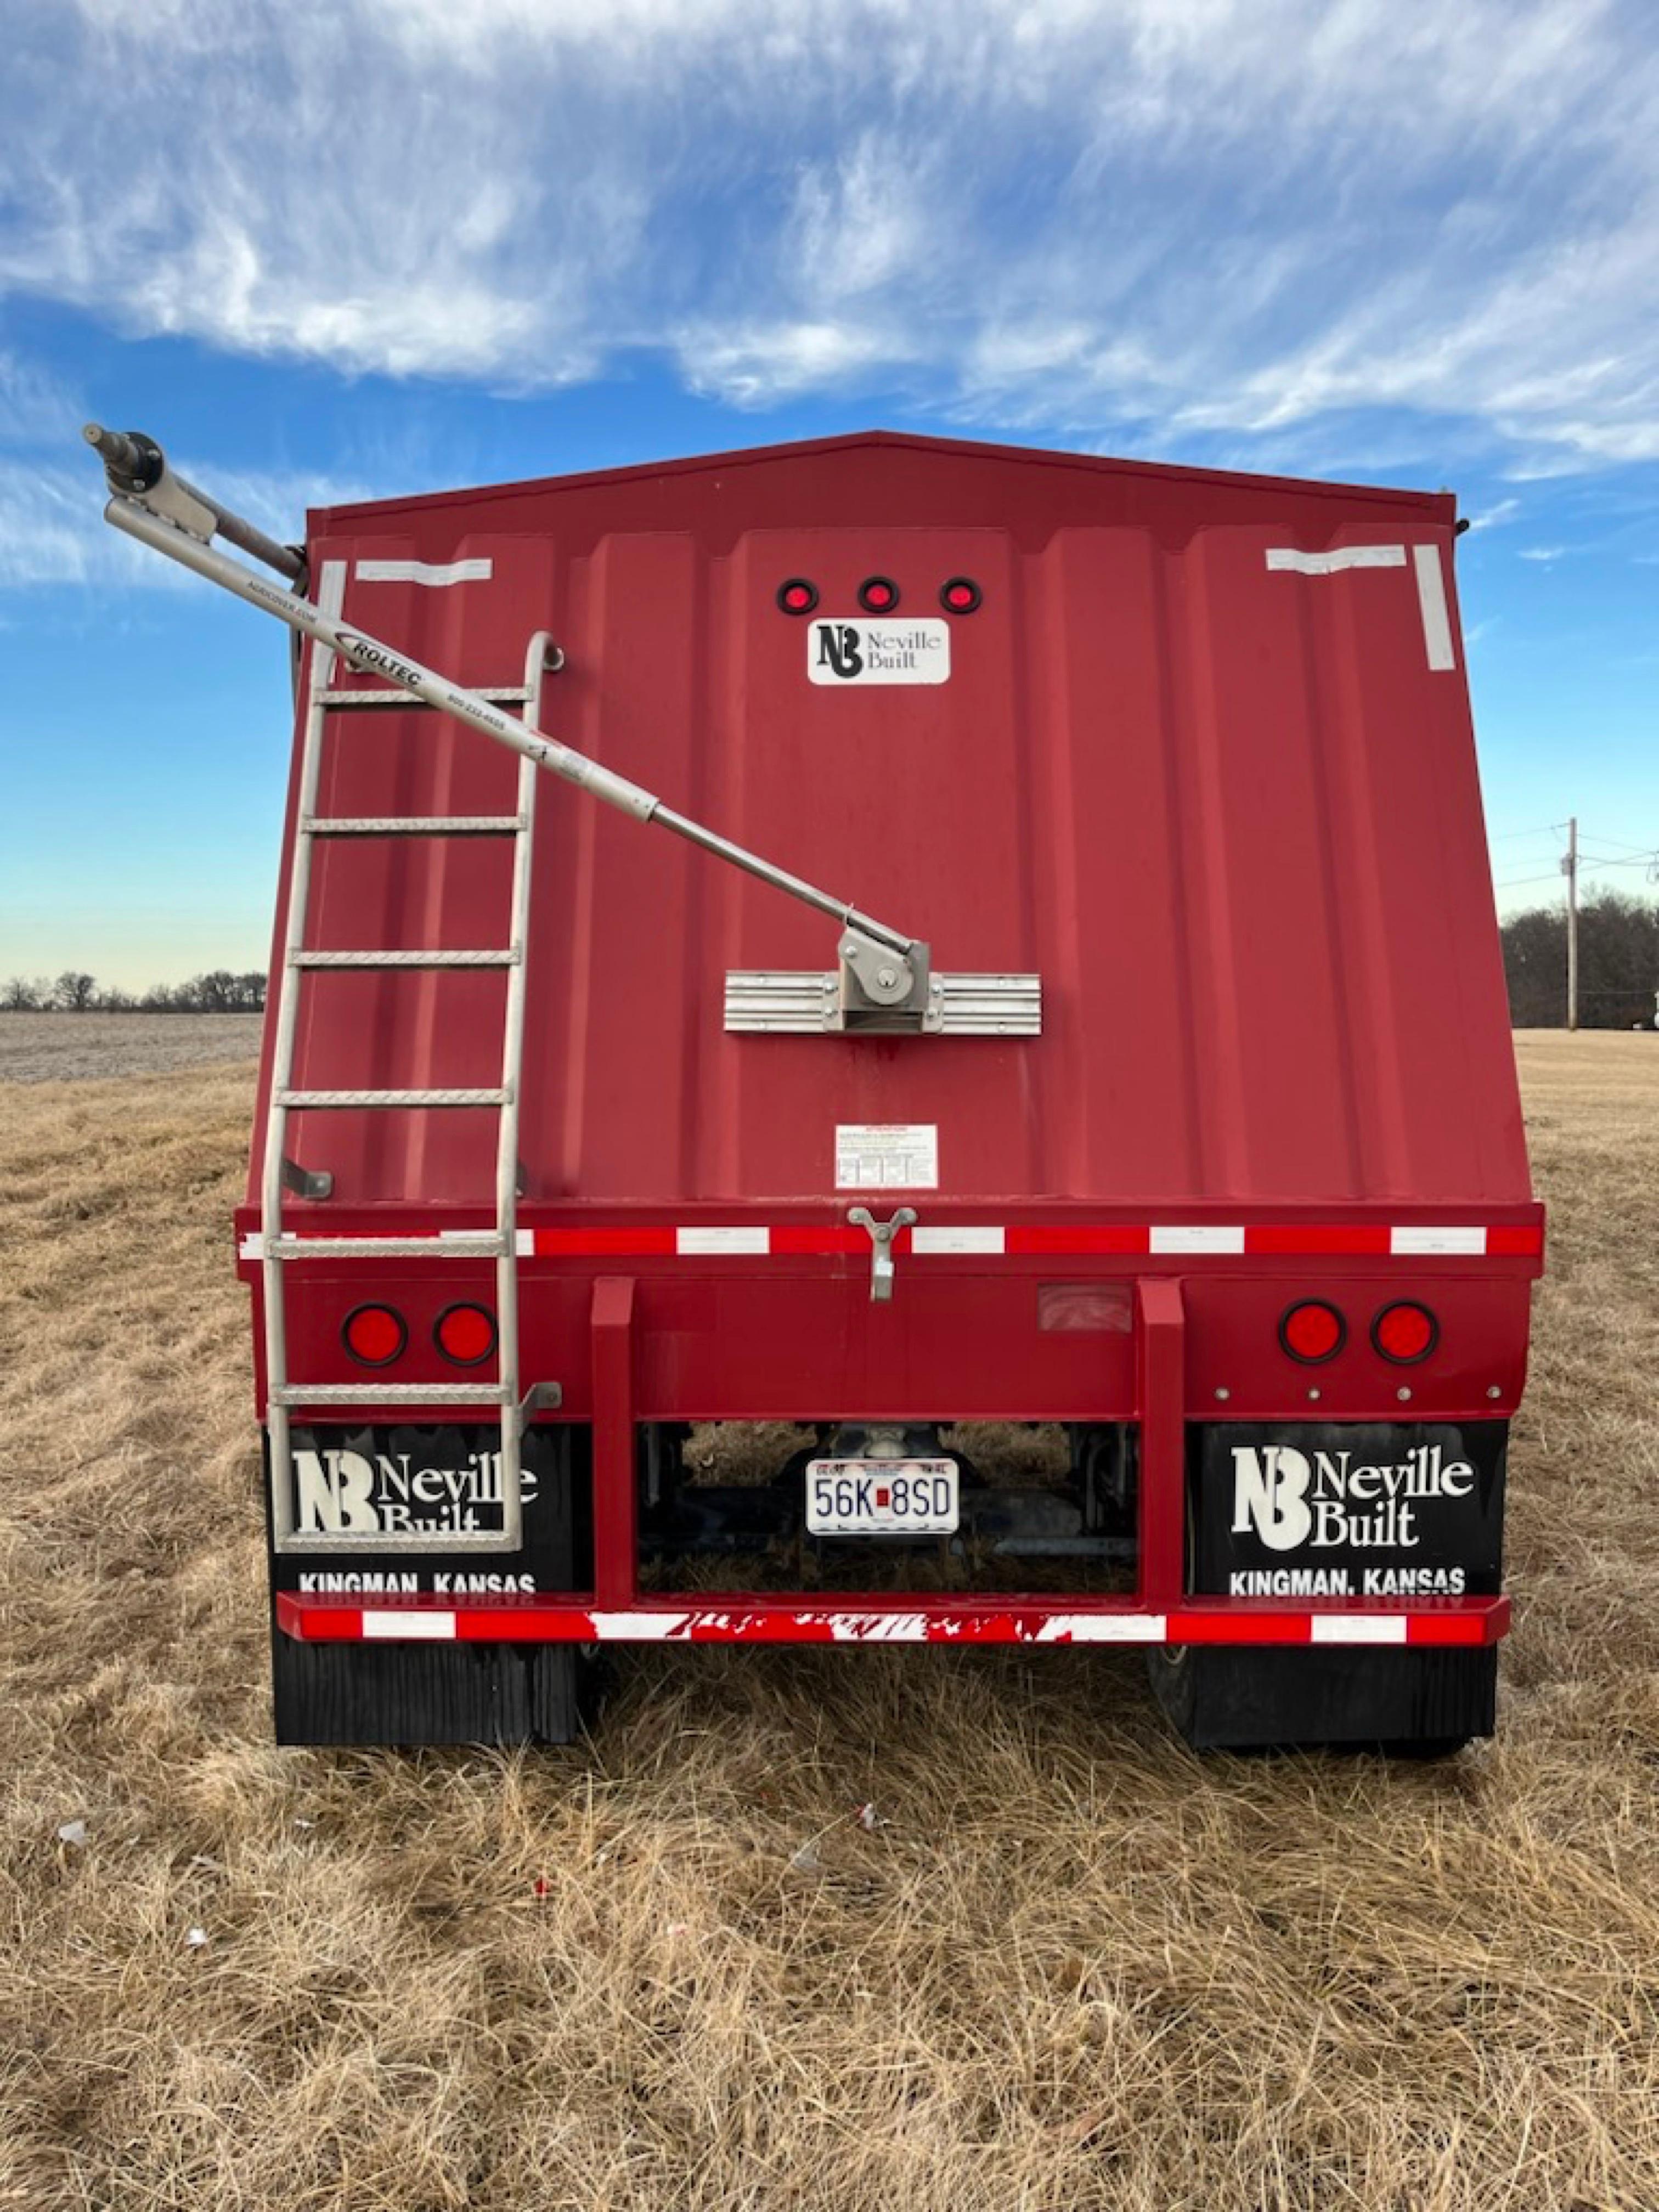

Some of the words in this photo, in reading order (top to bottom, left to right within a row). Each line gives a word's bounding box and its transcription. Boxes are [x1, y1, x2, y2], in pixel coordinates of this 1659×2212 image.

[868, 631, 941, 650] Neville
[868, 651, 917, 669] Built
[354, 641, 422, 685] ROLTEC
[375, 1451, 539, 1502] Neville
[1312, 1444, 1474, 1499] Neville
[815, 1478, 873, 1517] 56K
[892, 1477, 951, 1517] 8SD
[1309, 1498, 1420, 1547] Built
[433, 1573, 536, 1593] KANSAS
[1363, 1567, 1465, 1595] KANSAS
